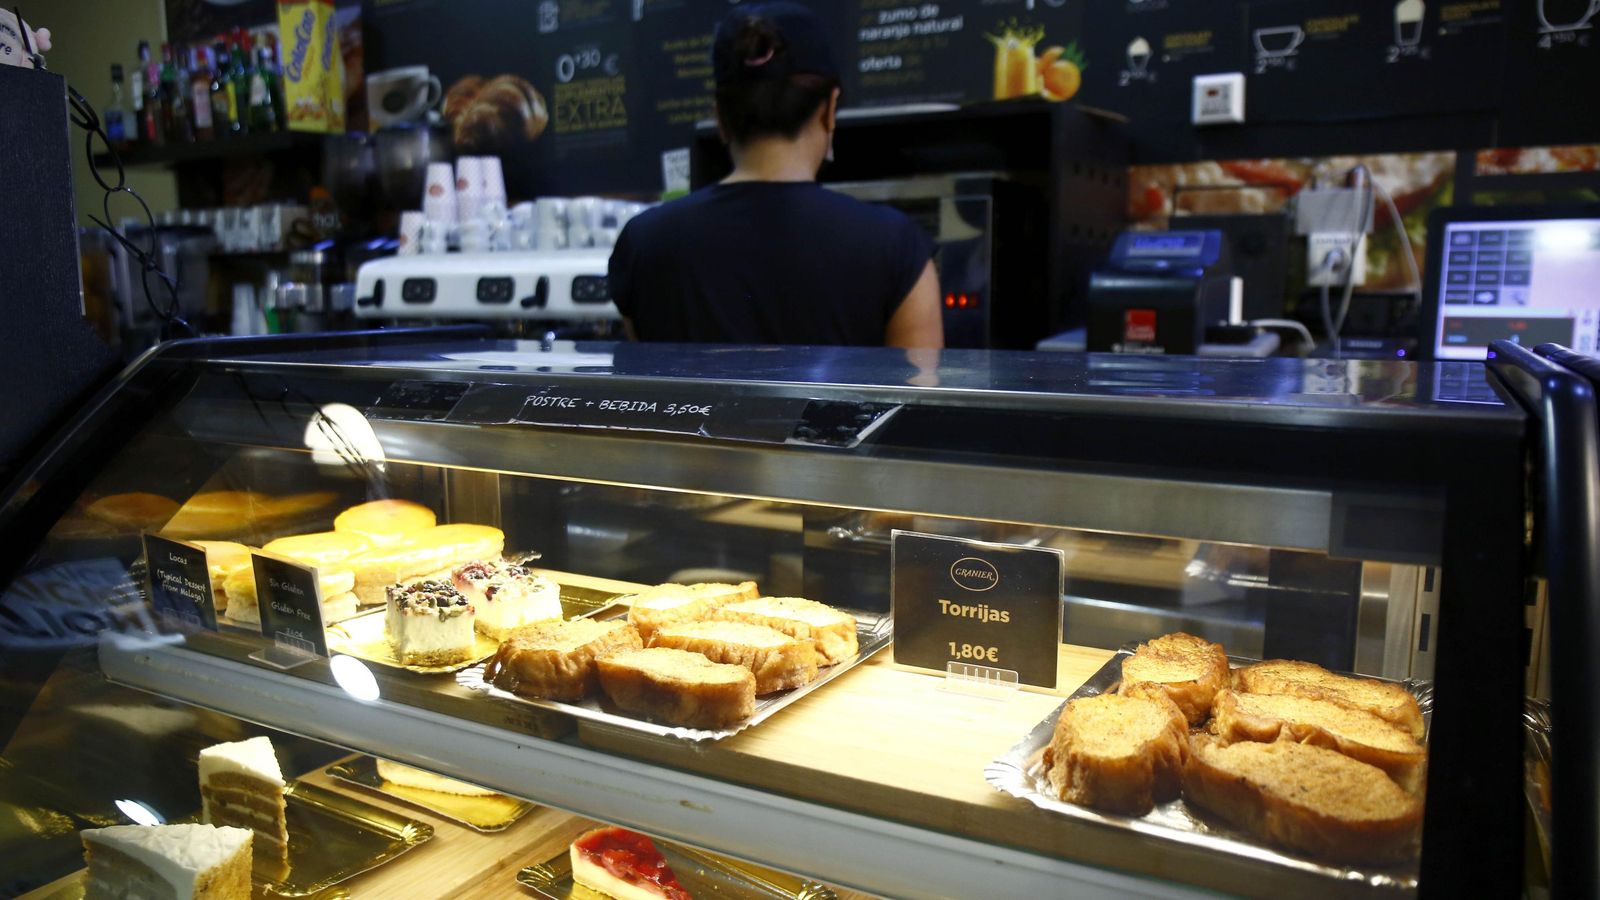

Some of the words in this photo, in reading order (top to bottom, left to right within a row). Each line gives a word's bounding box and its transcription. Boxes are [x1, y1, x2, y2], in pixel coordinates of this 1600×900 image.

[878, 6, 917, 24] zumo
[919, 3, 939, 19] de
[858, 23, 911, 41] naranja
[912, 14, 964, 35] natural
[858, 54, 903, 73] oferta
[555, 95, 627, 124] EXTRA
[524, 395, 582, 409] POSTRE
[585, 400, 594, 409] +
[599, 399, 657, 412] BEBIDA
[663, 403, 713, 416] 3,50€
[157, 568, 183, 584] (Typical
[184, 578, 206, 592] Dessert
[955, 567, 995, 582] GRANIER
[162, 582, 178, 593] from
[281, 582, 304, 596] Gluten
[271, 601, 295, 614] Gluten
[938, 599, 1011, 623] Torrijas
[949, 641, 999, 663] 1,80€
